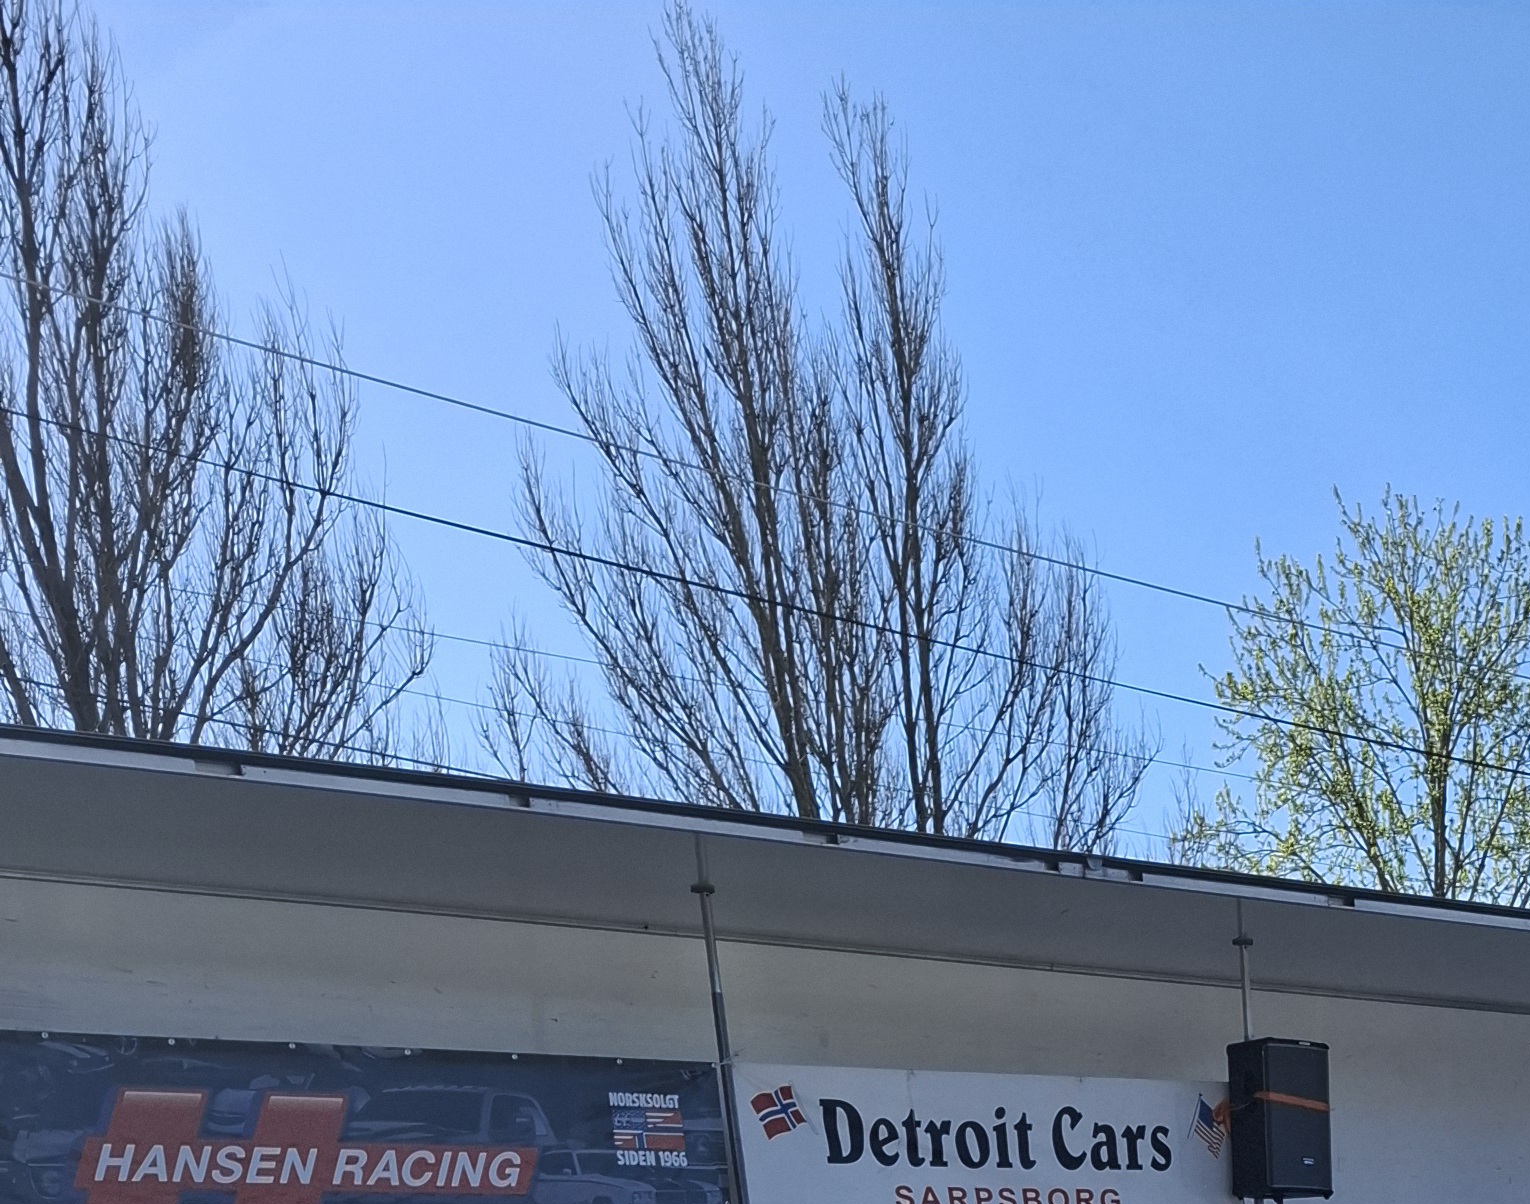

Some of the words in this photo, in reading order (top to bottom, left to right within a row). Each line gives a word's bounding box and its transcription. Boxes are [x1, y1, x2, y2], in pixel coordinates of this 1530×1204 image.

[608, 1092, 679, 1108] NORSKSOLGT
[818, 1098, 1039, 1170] Detroit
[1051, 1105, 1173, 1173] Cars
[94, 1143, 318, 1185] HANSEN
[332, 1148, 522, 1188] RACING
[616, 1150, 656, 1166] SIDEN
[658, 1151, 688, 1167] 1966
